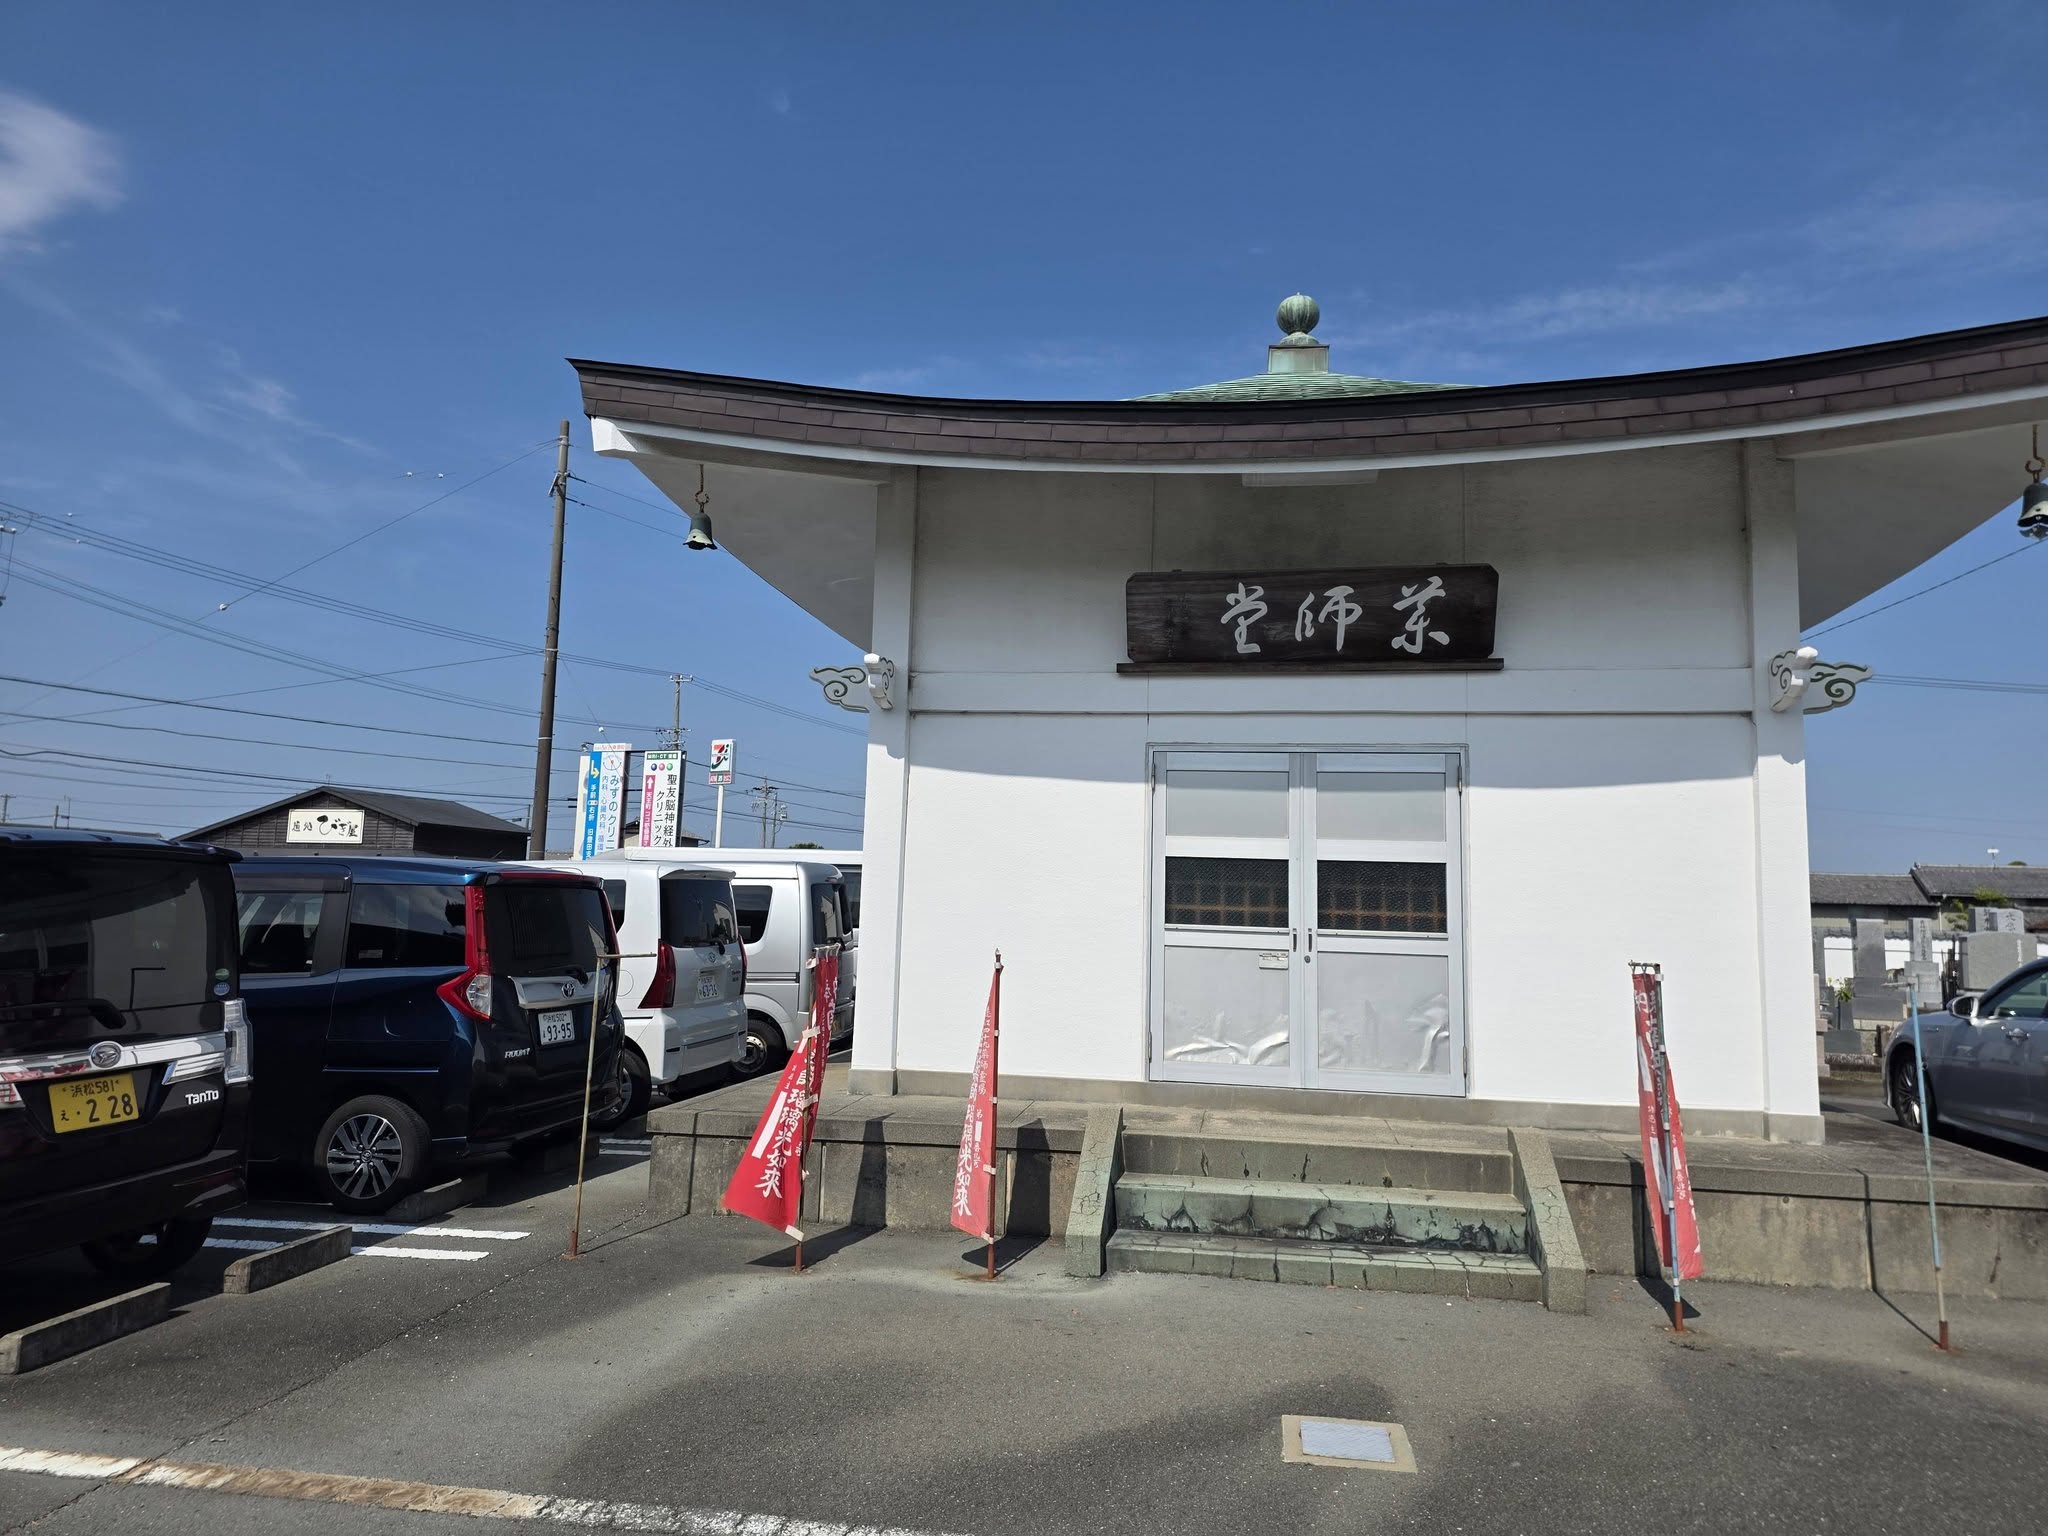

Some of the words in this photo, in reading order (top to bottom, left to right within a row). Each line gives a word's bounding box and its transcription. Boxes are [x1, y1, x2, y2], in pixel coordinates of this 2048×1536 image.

[654, 791, 665, 846] クリニック
